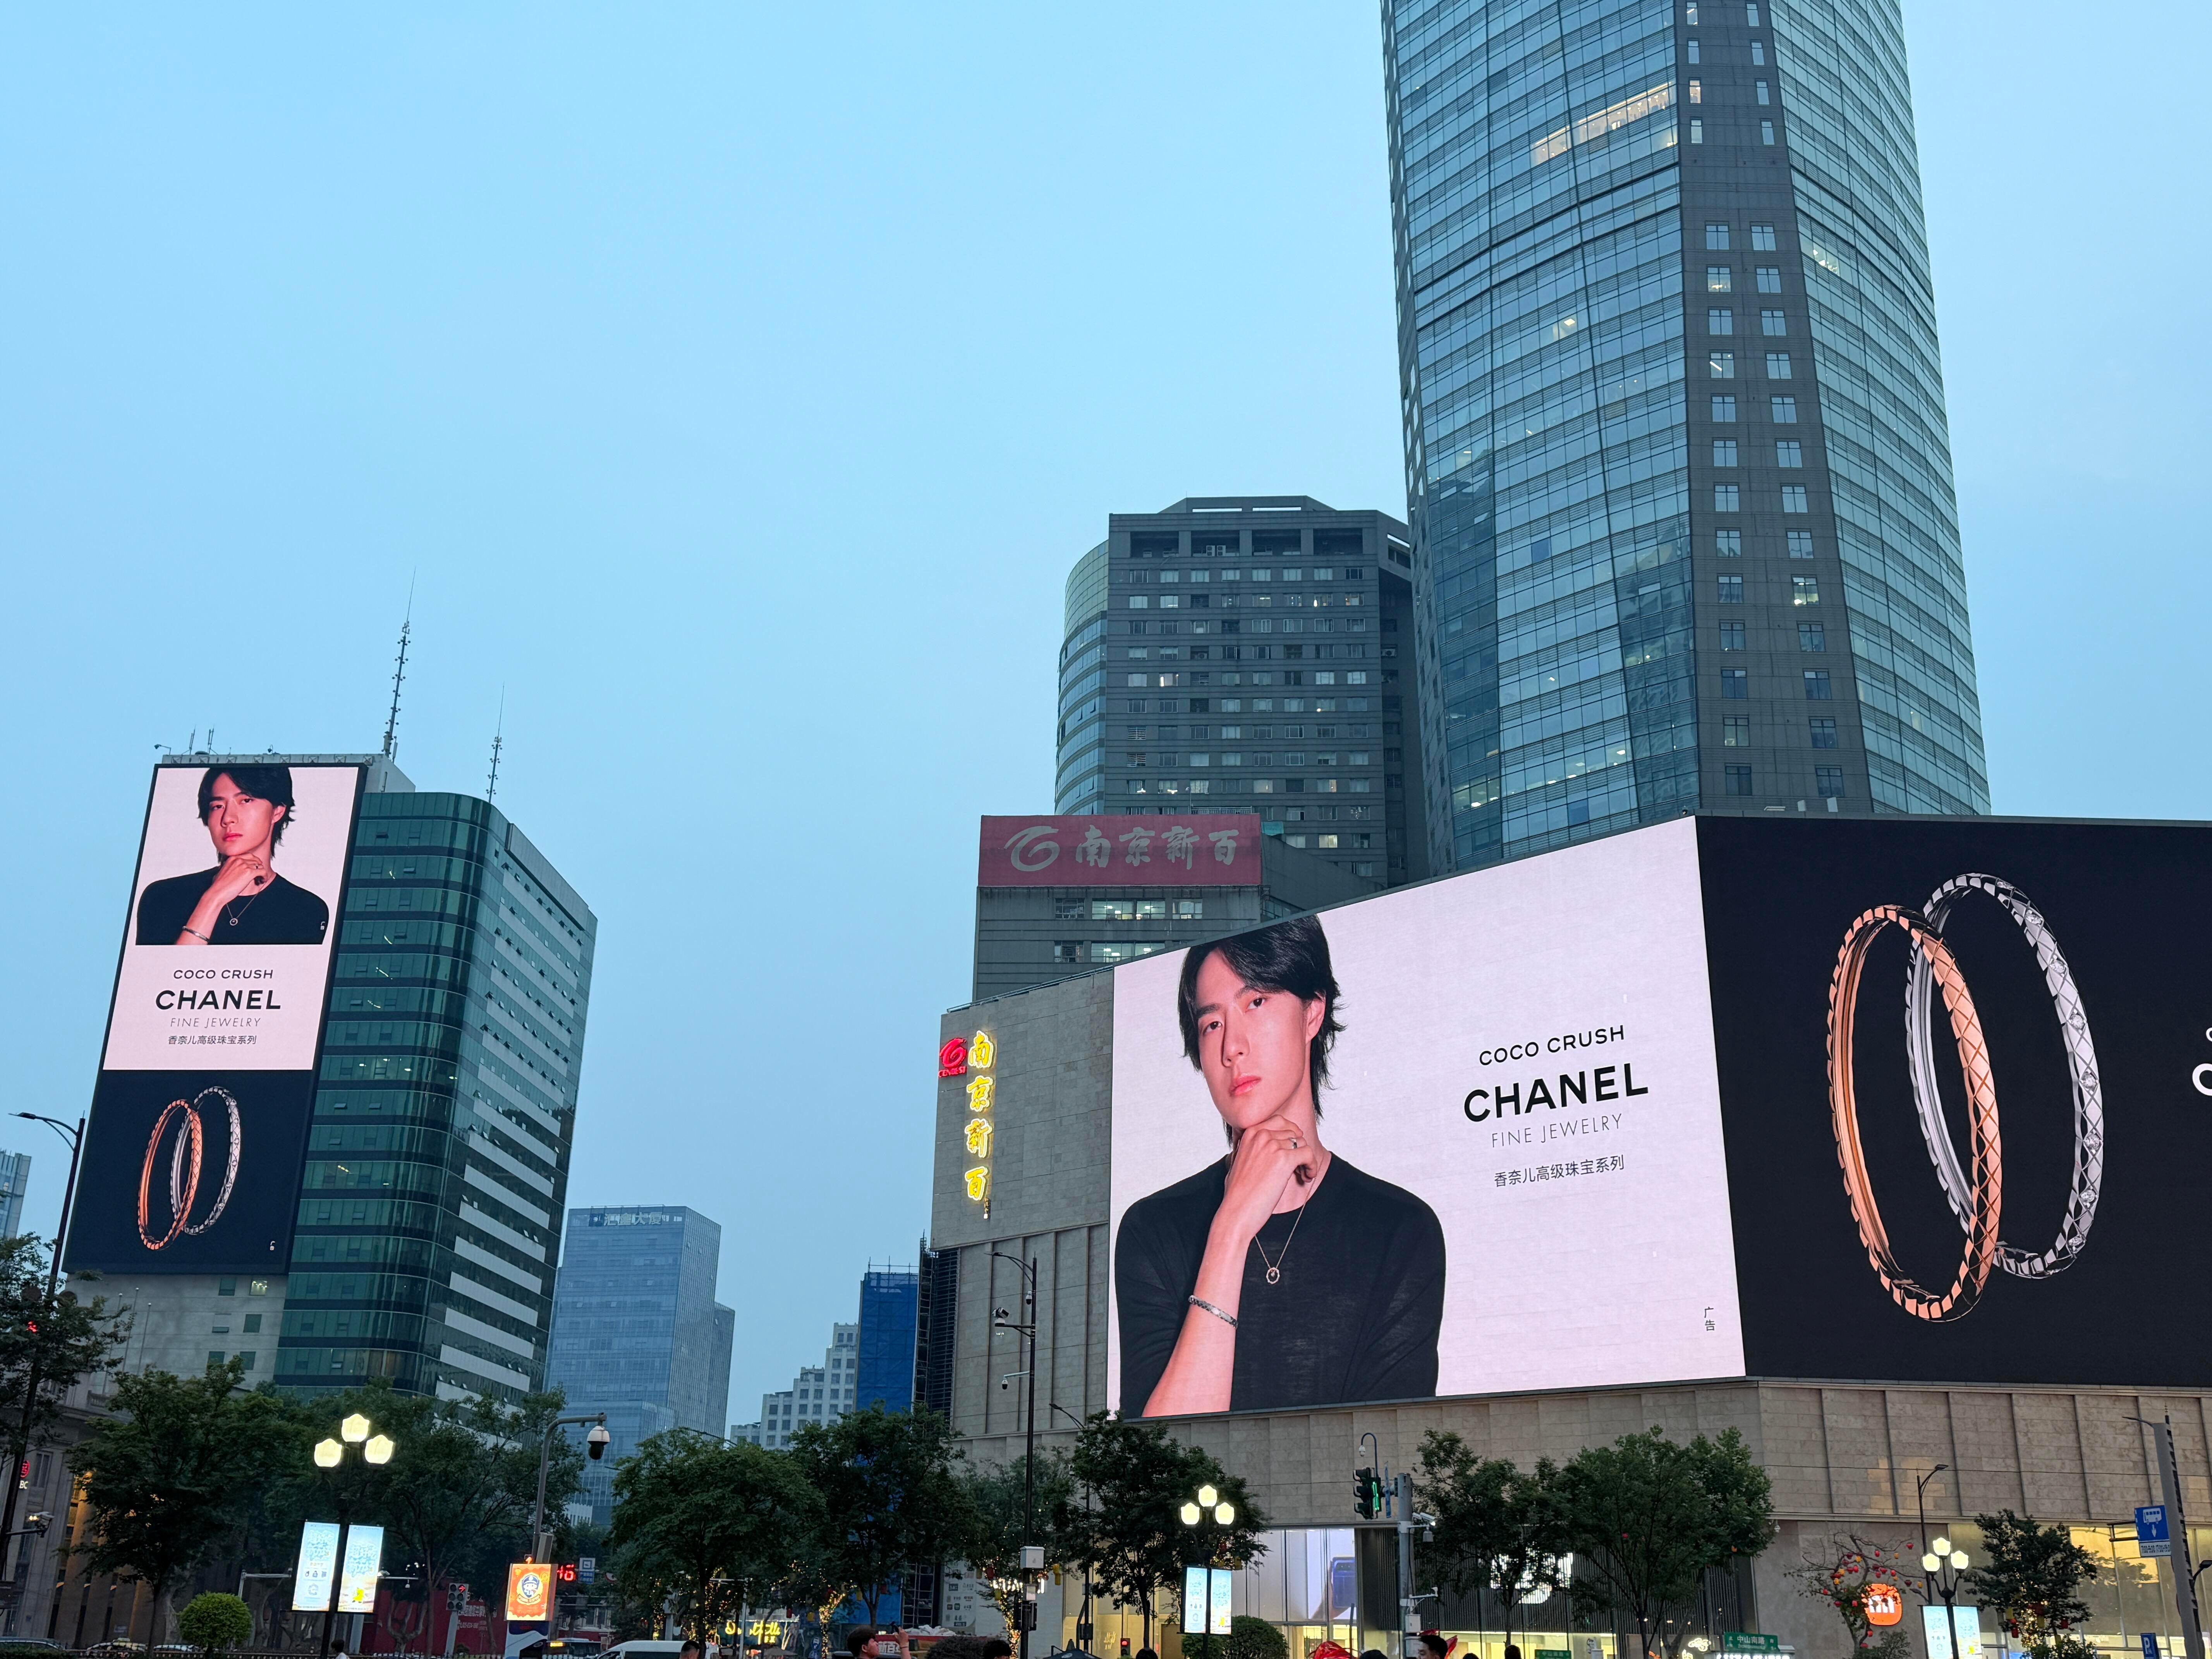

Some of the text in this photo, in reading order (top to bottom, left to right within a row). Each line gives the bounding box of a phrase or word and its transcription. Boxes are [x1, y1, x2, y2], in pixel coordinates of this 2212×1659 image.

[1076, 824, 1240, 870] 南京新百
[173, 970, 273, 979] COCO CRUSH
[156, 990, 281, 1010] CHANEL
[170, 1018, 261, 1028] FINE JEWELRY
[168, 1035, 256, 1044] 香奈儿高级珠宝系列
[1479, 1025, 1625, 1066] COCO CRUSH
[1464, 1063, 1649, 1122] CHANEL
[965, 1030, 994, 1201] 南京新百
[1492, 1113, 1622, 1147] FINE JEWELRY
[1494, 1154, 1624, 1188] 香奈儿高级珠宝系列
[1704, 1307, 1715, 1331] 广告
[2143, 1637, 2150, 1654] P
